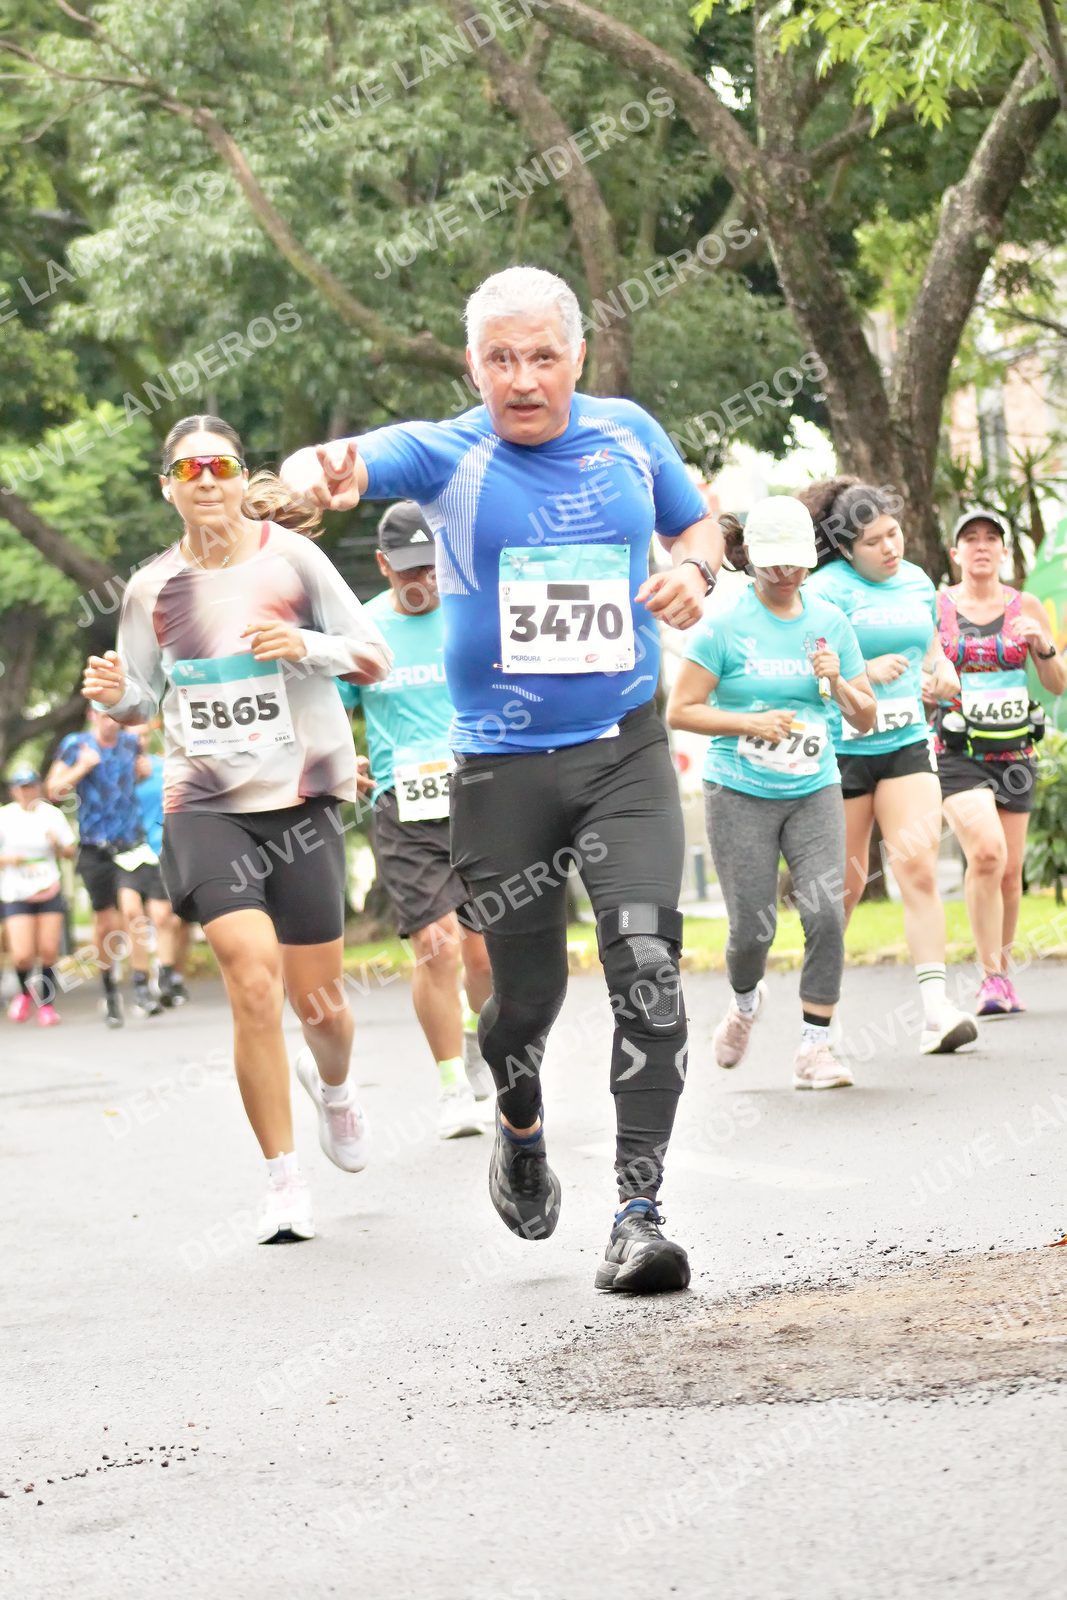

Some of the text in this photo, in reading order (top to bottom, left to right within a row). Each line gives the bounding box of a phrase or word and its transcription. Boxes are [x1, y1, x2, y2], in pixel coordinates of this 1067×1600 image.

[509, 603, 623, 642] 3470
[744, 659, 815, 675] PERDU
[190, 692, 280, 730] 5865
[969, 700, 1025, 721] 4463
[850, 711, 914, 738] 152
